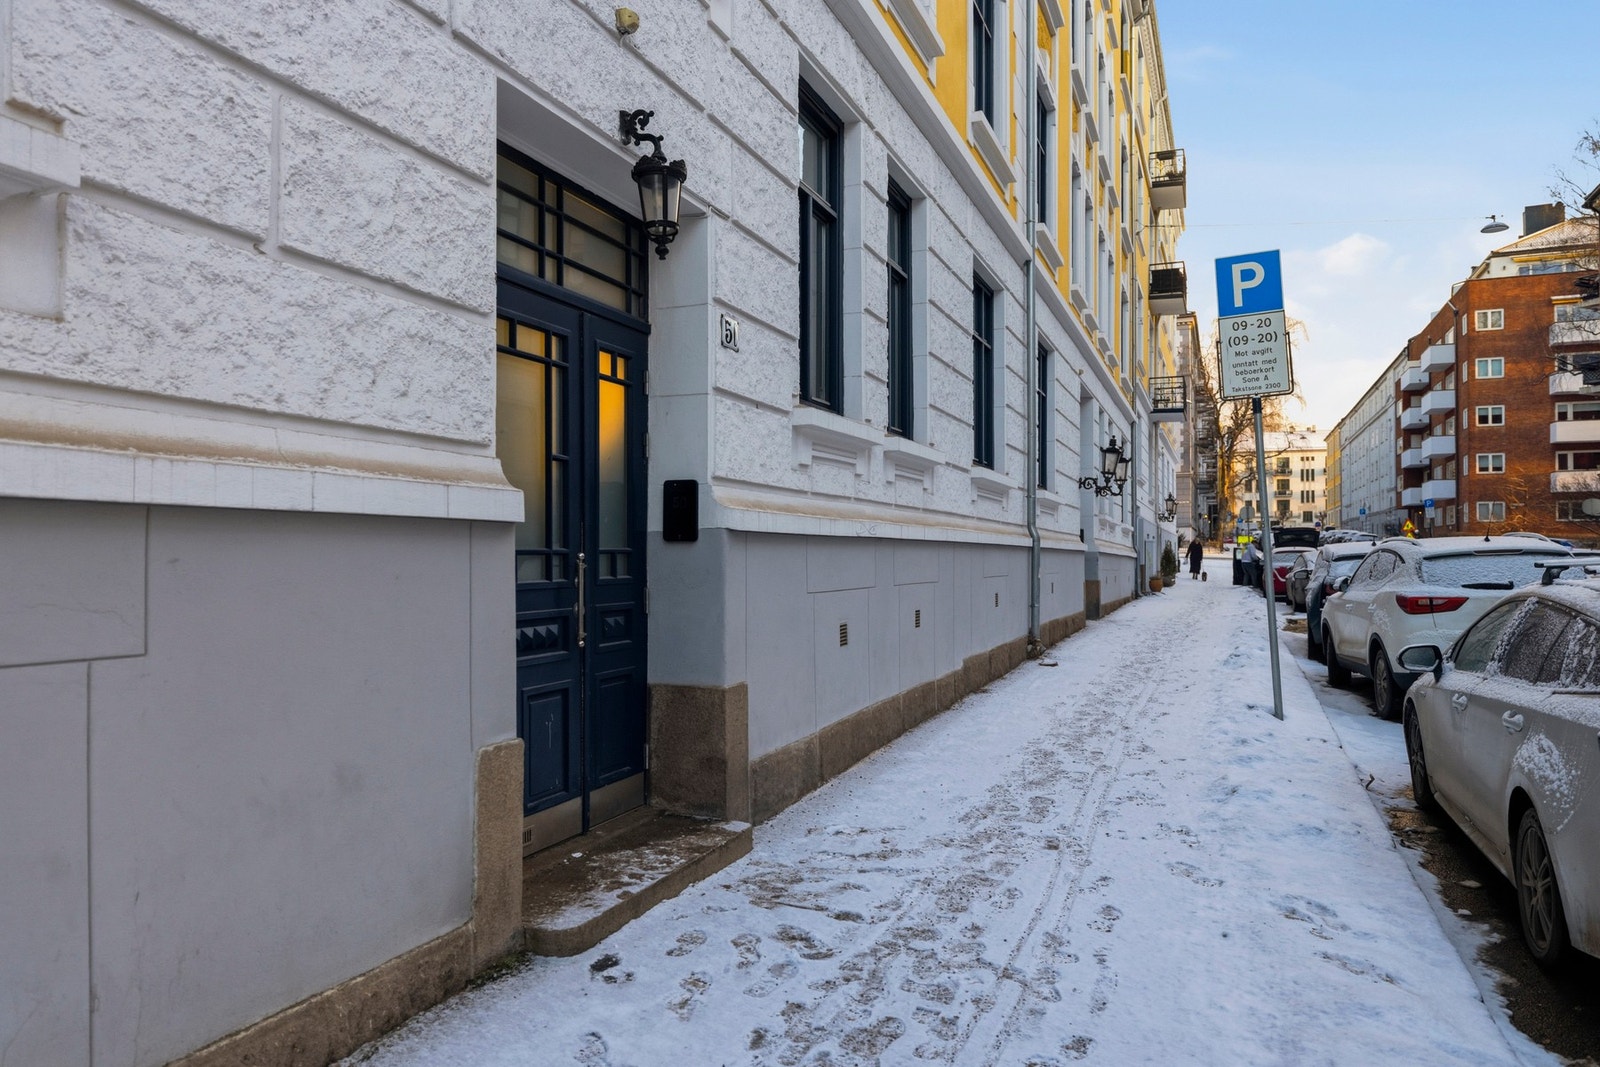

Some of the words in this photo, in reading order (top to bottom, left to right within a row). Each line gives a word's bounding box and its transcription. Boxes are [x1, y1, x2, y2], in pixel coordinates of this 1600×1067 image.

[1231, 261, 1265, 308] P
[1232, 317, 1272, 331] 09-20
[725, 319, 737, 347] 51
[1251, 347, 1273, 356] avgift
[1232, 360, 1258, 368] unntatt
[1261, 357, 1277, 365] med
[1235, 366, 1275, 376] beboerkort
